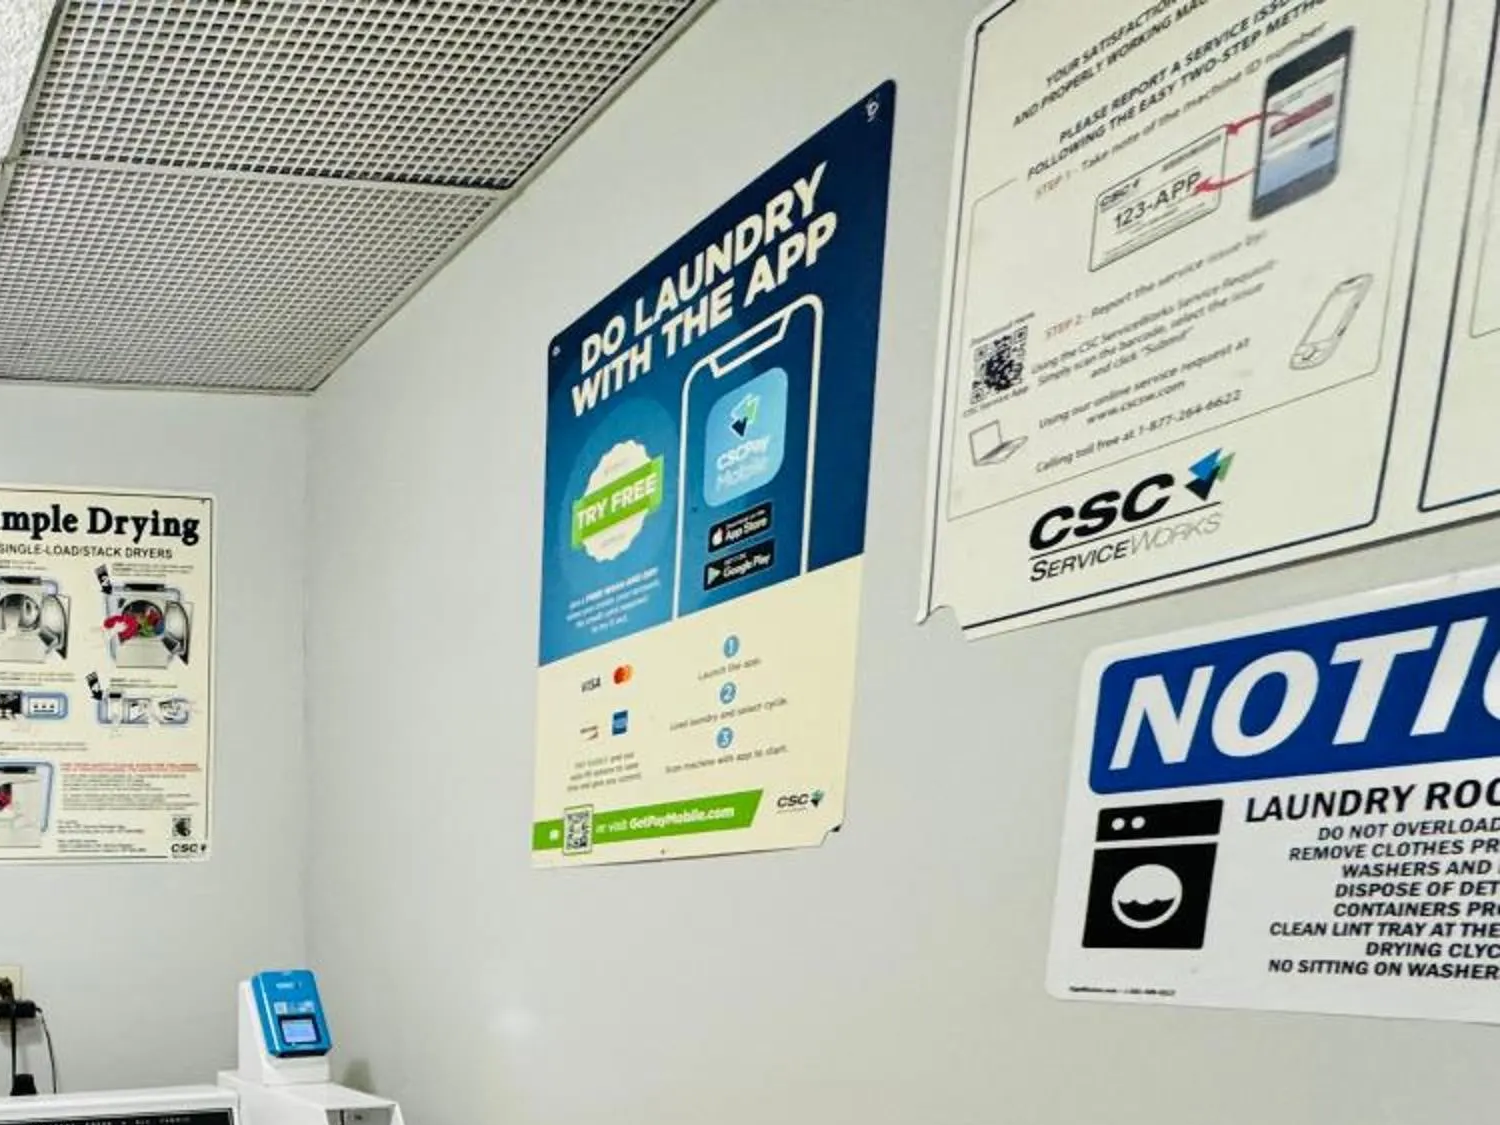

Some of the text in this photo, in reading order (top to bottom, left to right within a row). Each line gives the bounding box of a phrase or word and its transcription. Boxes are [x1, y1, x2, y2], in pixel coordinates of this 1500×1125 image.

[1060, 17, 1250, 144] PLEASE REPORT A SERVICE
[1013, 103, 1039, 128] AND
[1027, 124, 1106, 181] FOLLOWING
[1109, 105, 1136, 130] THE
[1139, 79, 1178, 113] EASY
[1114, 170, 1202, 229] 123-APP
[582, 161, 827, 375] DO LAUNDRY
[572, 211, 837, 417] WITH THE APP
[578, 472, 658, 529] TRY FREE
[1029, 473, 1175, 550] CSC
[87, 506, 200, 546] Drying
[125, 546, 173, 559] DRYERS
[1108, 616, 1500, 771] NOTI
[777, 793, 809, 809] CSC
[1245, 784, 1417, 823] LAUNDRY
[1317, 826, 1344, 841] DO
[1350, 823, 1388, 839] NOT
[171, 843, 198, 853] CSC
[1289, 843, 1367, 862] REMOVE
[1371, 839, 1465, 858] CLOTHES
[1341, 860, 1440, 879] WASHERS
[1445, 859, 1492, 876] AND
[1335, 881, 1422, 898] DISPOSE
[1426, 881, 1456, 896] OF
[1333, 902, 1461, 918] CONTAINERS
[1269, 921, 1500, 938] CLEAN LINT TRAY AT THE
[1365, 941, 1443, 958] DRYING
[1268, 959, 1293, 974] NO
[1297, 959, 1369, 975] SITTING
[1374, 961, 1402, 977] ON
